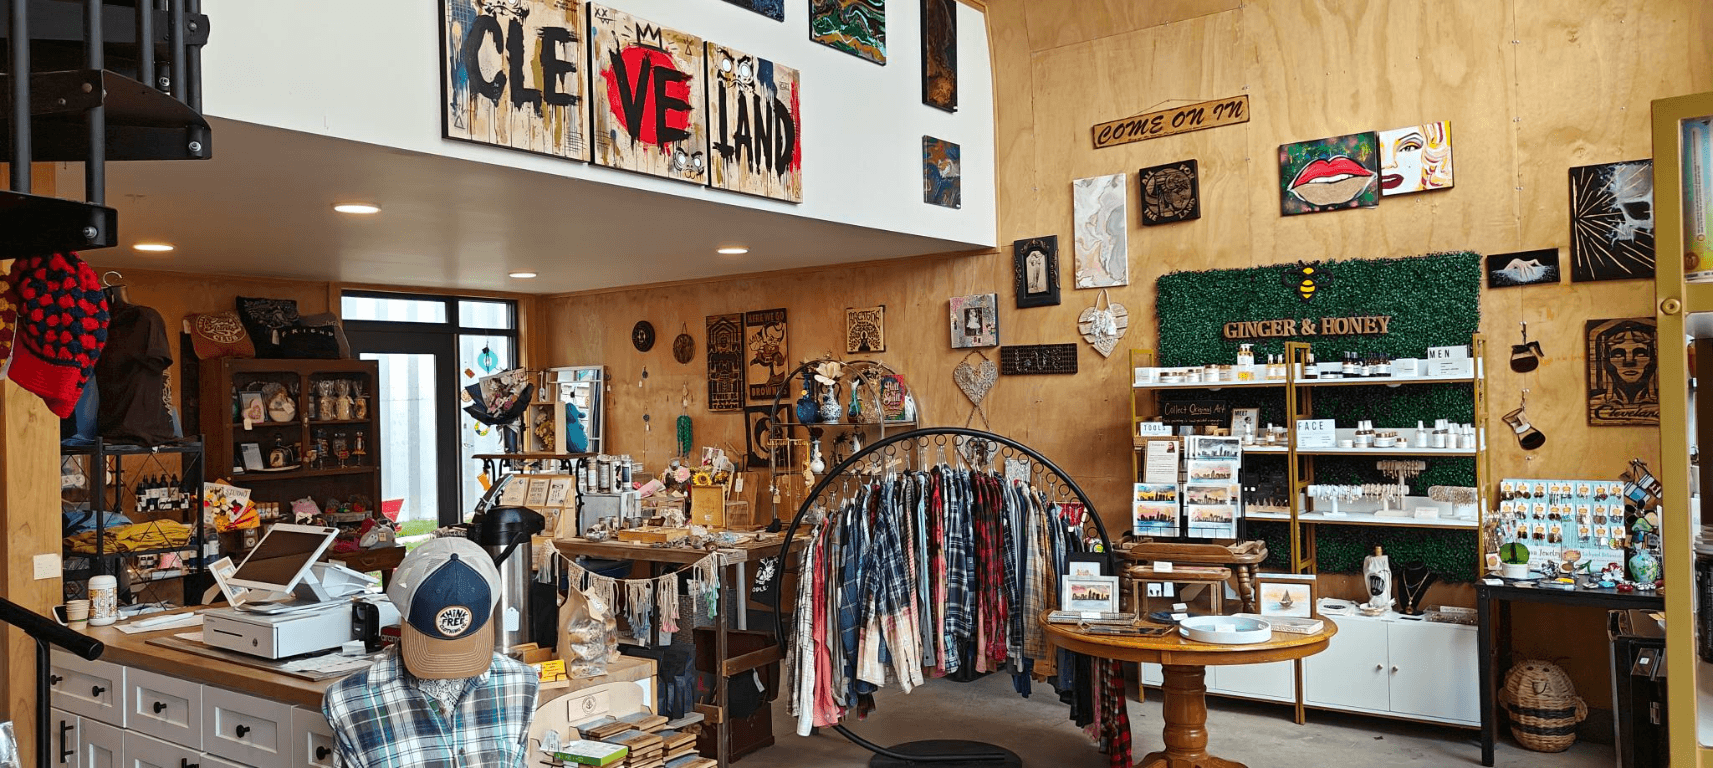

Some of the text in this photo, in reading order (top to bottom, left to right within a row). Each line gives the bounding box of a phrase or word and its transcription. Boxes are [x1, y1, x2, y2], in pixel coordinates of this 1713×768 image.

[464, 15, 581, 114] CLE
[609, 47, 693, 148] VE
[712, 74, 797, 178] LAND
[1097, 100, 1244, 144] COME ON IN
[1179, 164, 1195, 180] FOR
[1143, 197, 1196, 222] THE LAND
[764, 312, 774, 321] WE
[775, 311, 785, 321] GO
[1223, 315, 1391, 338] GINGER & HONEY
[213, 333, 239, 343] CLUB
[1429, 349, 1450, 358] MEN
[751, 386, 787, 396] BROWNS
[1164, 402, 1226, 415] Collect Original Art
[1143, 424, 1167, 432] TOOLS
[1298, 421, 1324, 431] FACE
[1539, 548, 1561, 559] Jewelry
[442, 617, 466, 627] FREE
[380, 634, 401, 642] aram
